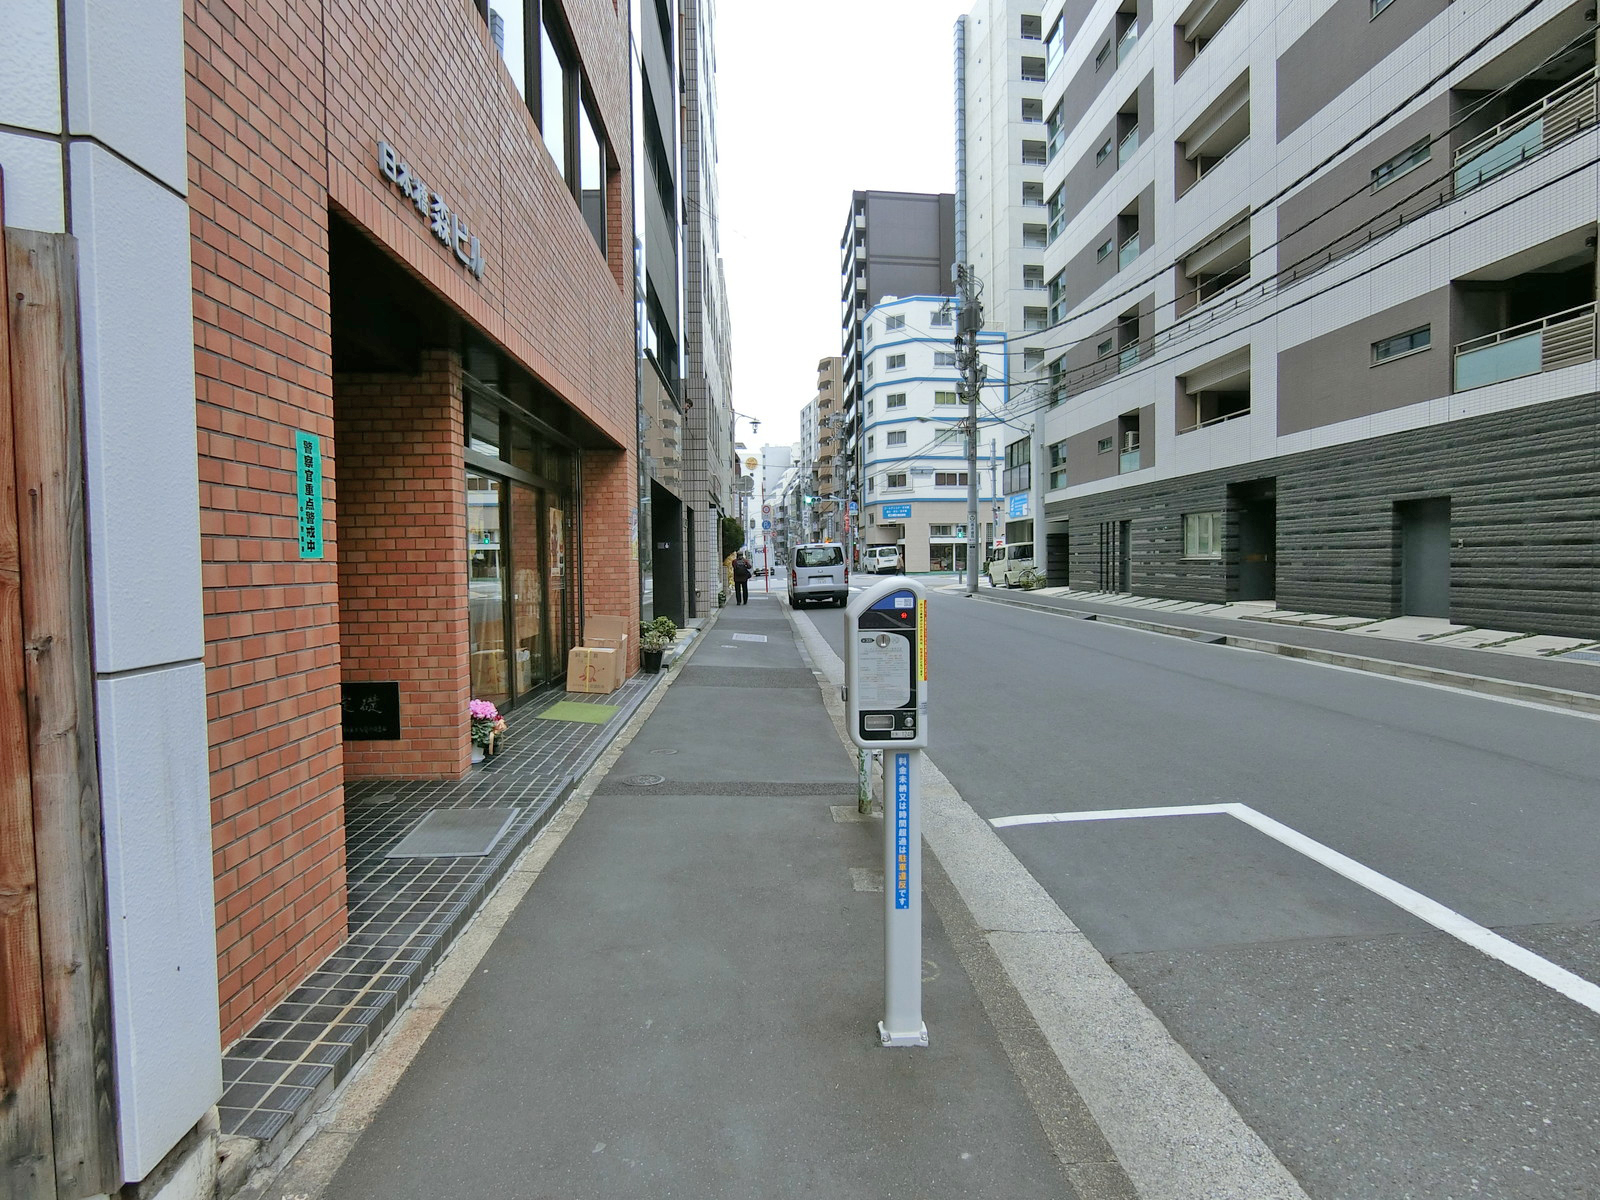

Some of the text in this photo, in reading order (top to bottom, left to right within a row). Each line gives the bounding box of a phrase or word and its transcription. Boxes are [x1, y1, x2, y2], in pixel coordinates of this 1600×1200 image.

[377, 141, 486, 280] 日本橋森ビル
[303, 440, 316, 552] 警察官重点警戒中
